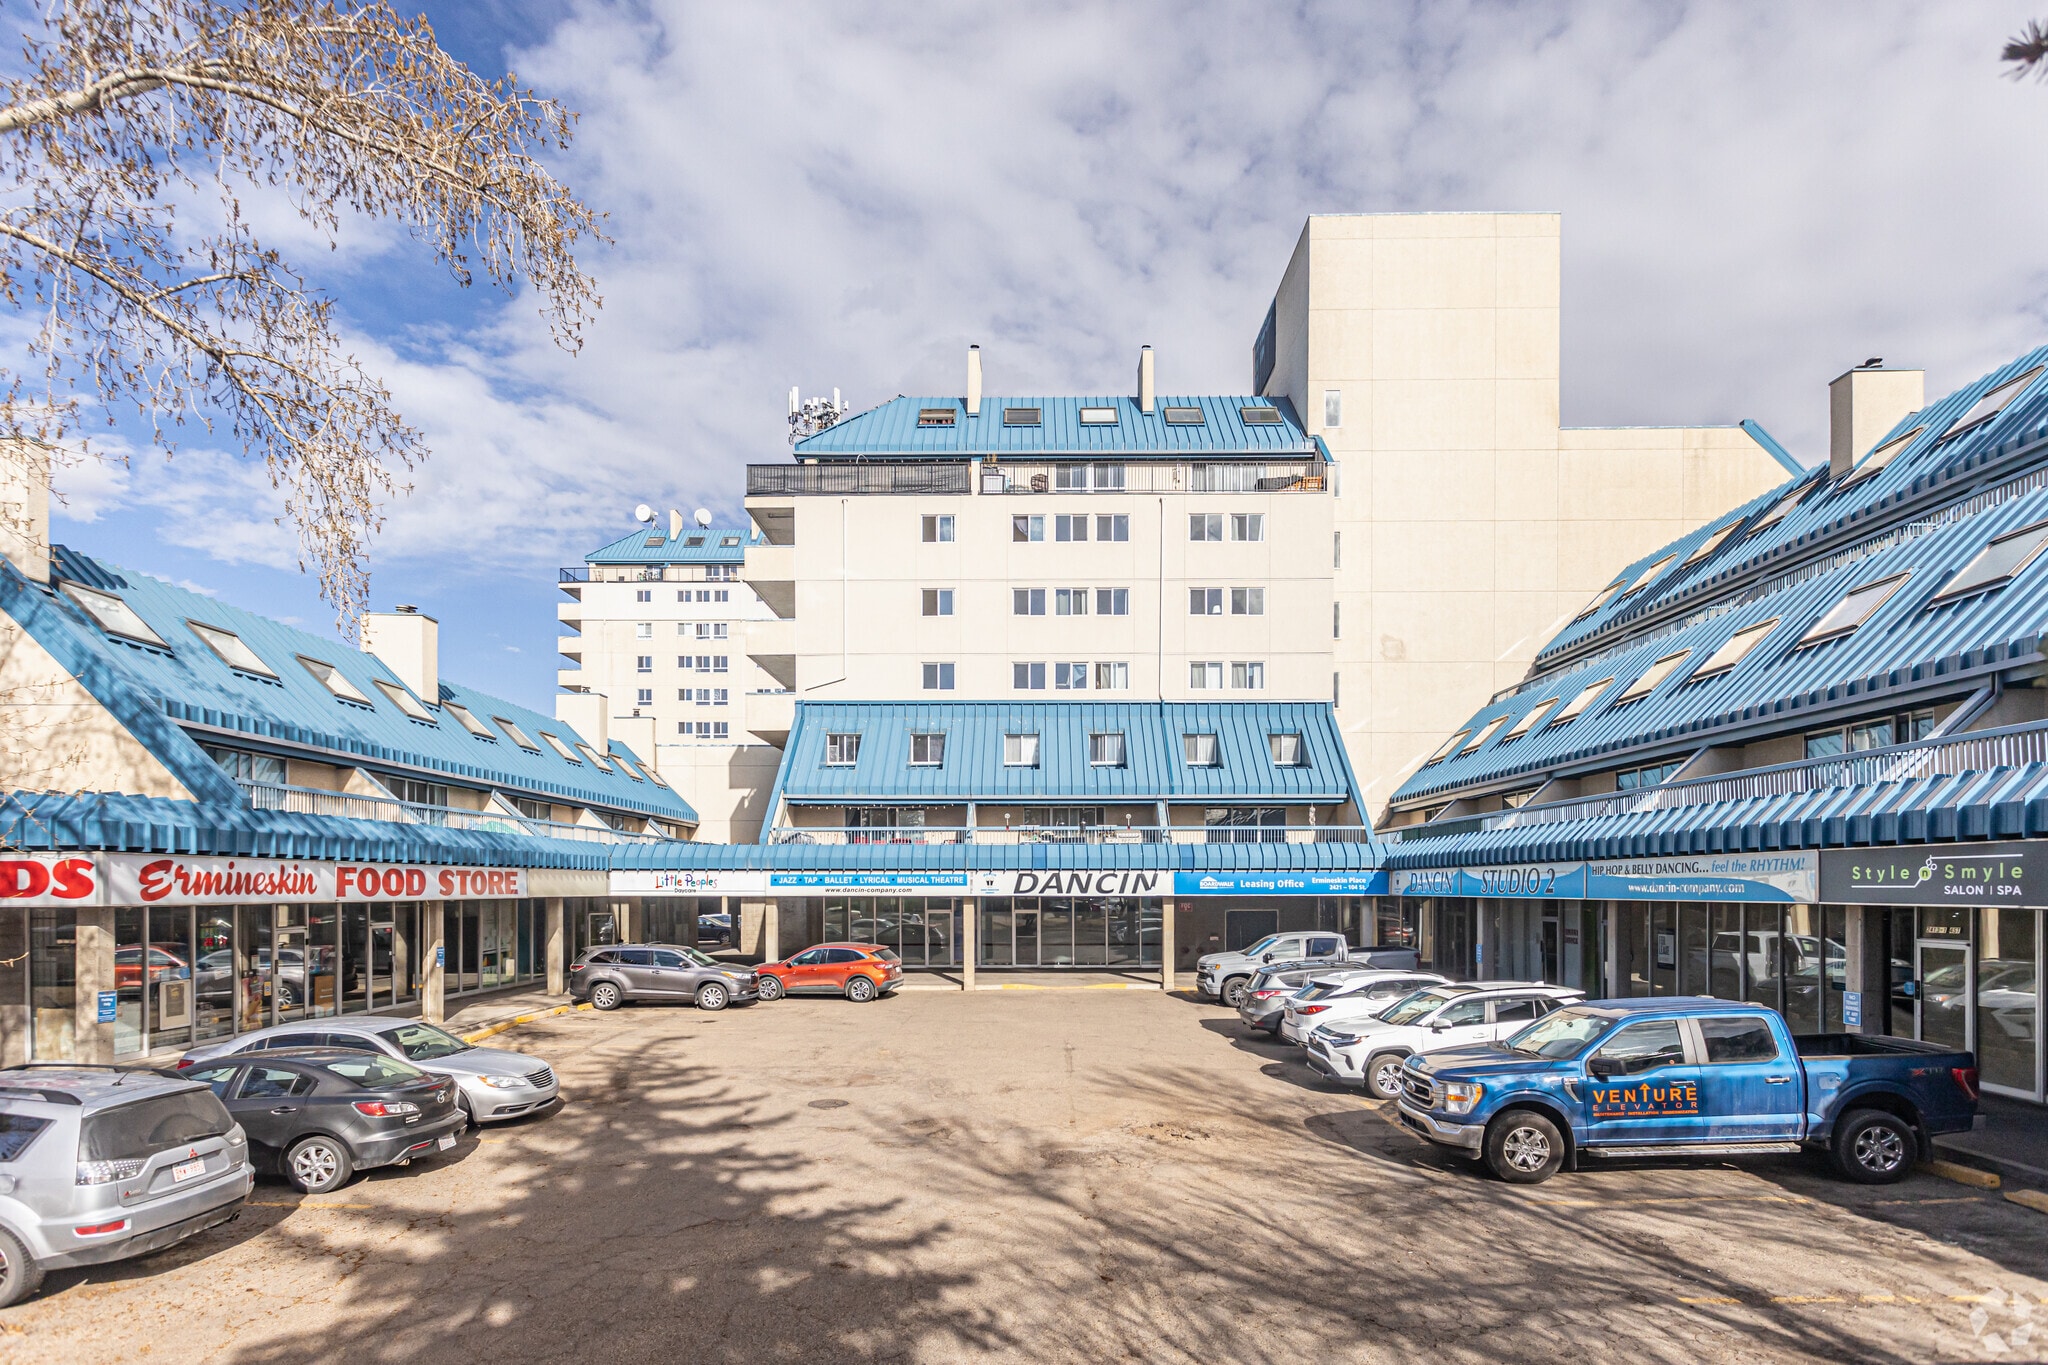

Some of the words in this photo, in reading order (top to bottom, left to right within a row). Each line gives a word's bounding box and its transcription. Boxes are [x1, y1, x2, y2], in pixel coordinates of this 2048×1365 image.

[1591, 866, 1605, 876] HIP
[1606, 865, 1624, 875] HOP
[1625, 865, 1630, 875] &
[1631, 863, 1654, 875] BELLY
[1711, 859, 1728, 874] feel
[1731, 859, 1747, 873] the
[1750, 857, 1806, 871] RHYTHM!
[1852, 864, 1911, 883] Style
[1944, 862, 2024, 882] Smyle
[0, 859, 95, 899] DS
[138, 860, 318, 902] Ermineskin
[336, 865, 427, 898] FOOD
[438, 867, 519, 896] STORE
[655, 874, 683, 889] Little
[685, 873, 718, 889] Peoples
[778, 876, 797, 884] JAZZ
[804, 876, 818, 884] TAP
[824, 876, 853, 884] BALLET
[859, 876, 890, 884] LYRICAL
[897, 876, 929, 884] MUSICAL
[930, 876, 964, 884] THEATRE
[1013, 873, 1159, 894] DANCIN
[1240, 880, 1275, 890] Leasing
[1277, 880, 1305, 888] Office
[1409, 872, 1452, 893] DANCIN
[1481, 868, 1541, 894] STUDIO
[1545, 868, 1557, 893] 2
[1627, 882, 1745, 896] www.dancin-company.com
[1944, 885, 1984, 896] SALON
[1997, 884, 2023, 896] SPA
[1592, 1083, 1698, 1104] VENTURE
[1592, 1102, 1698, 1111] ELEVATOR
